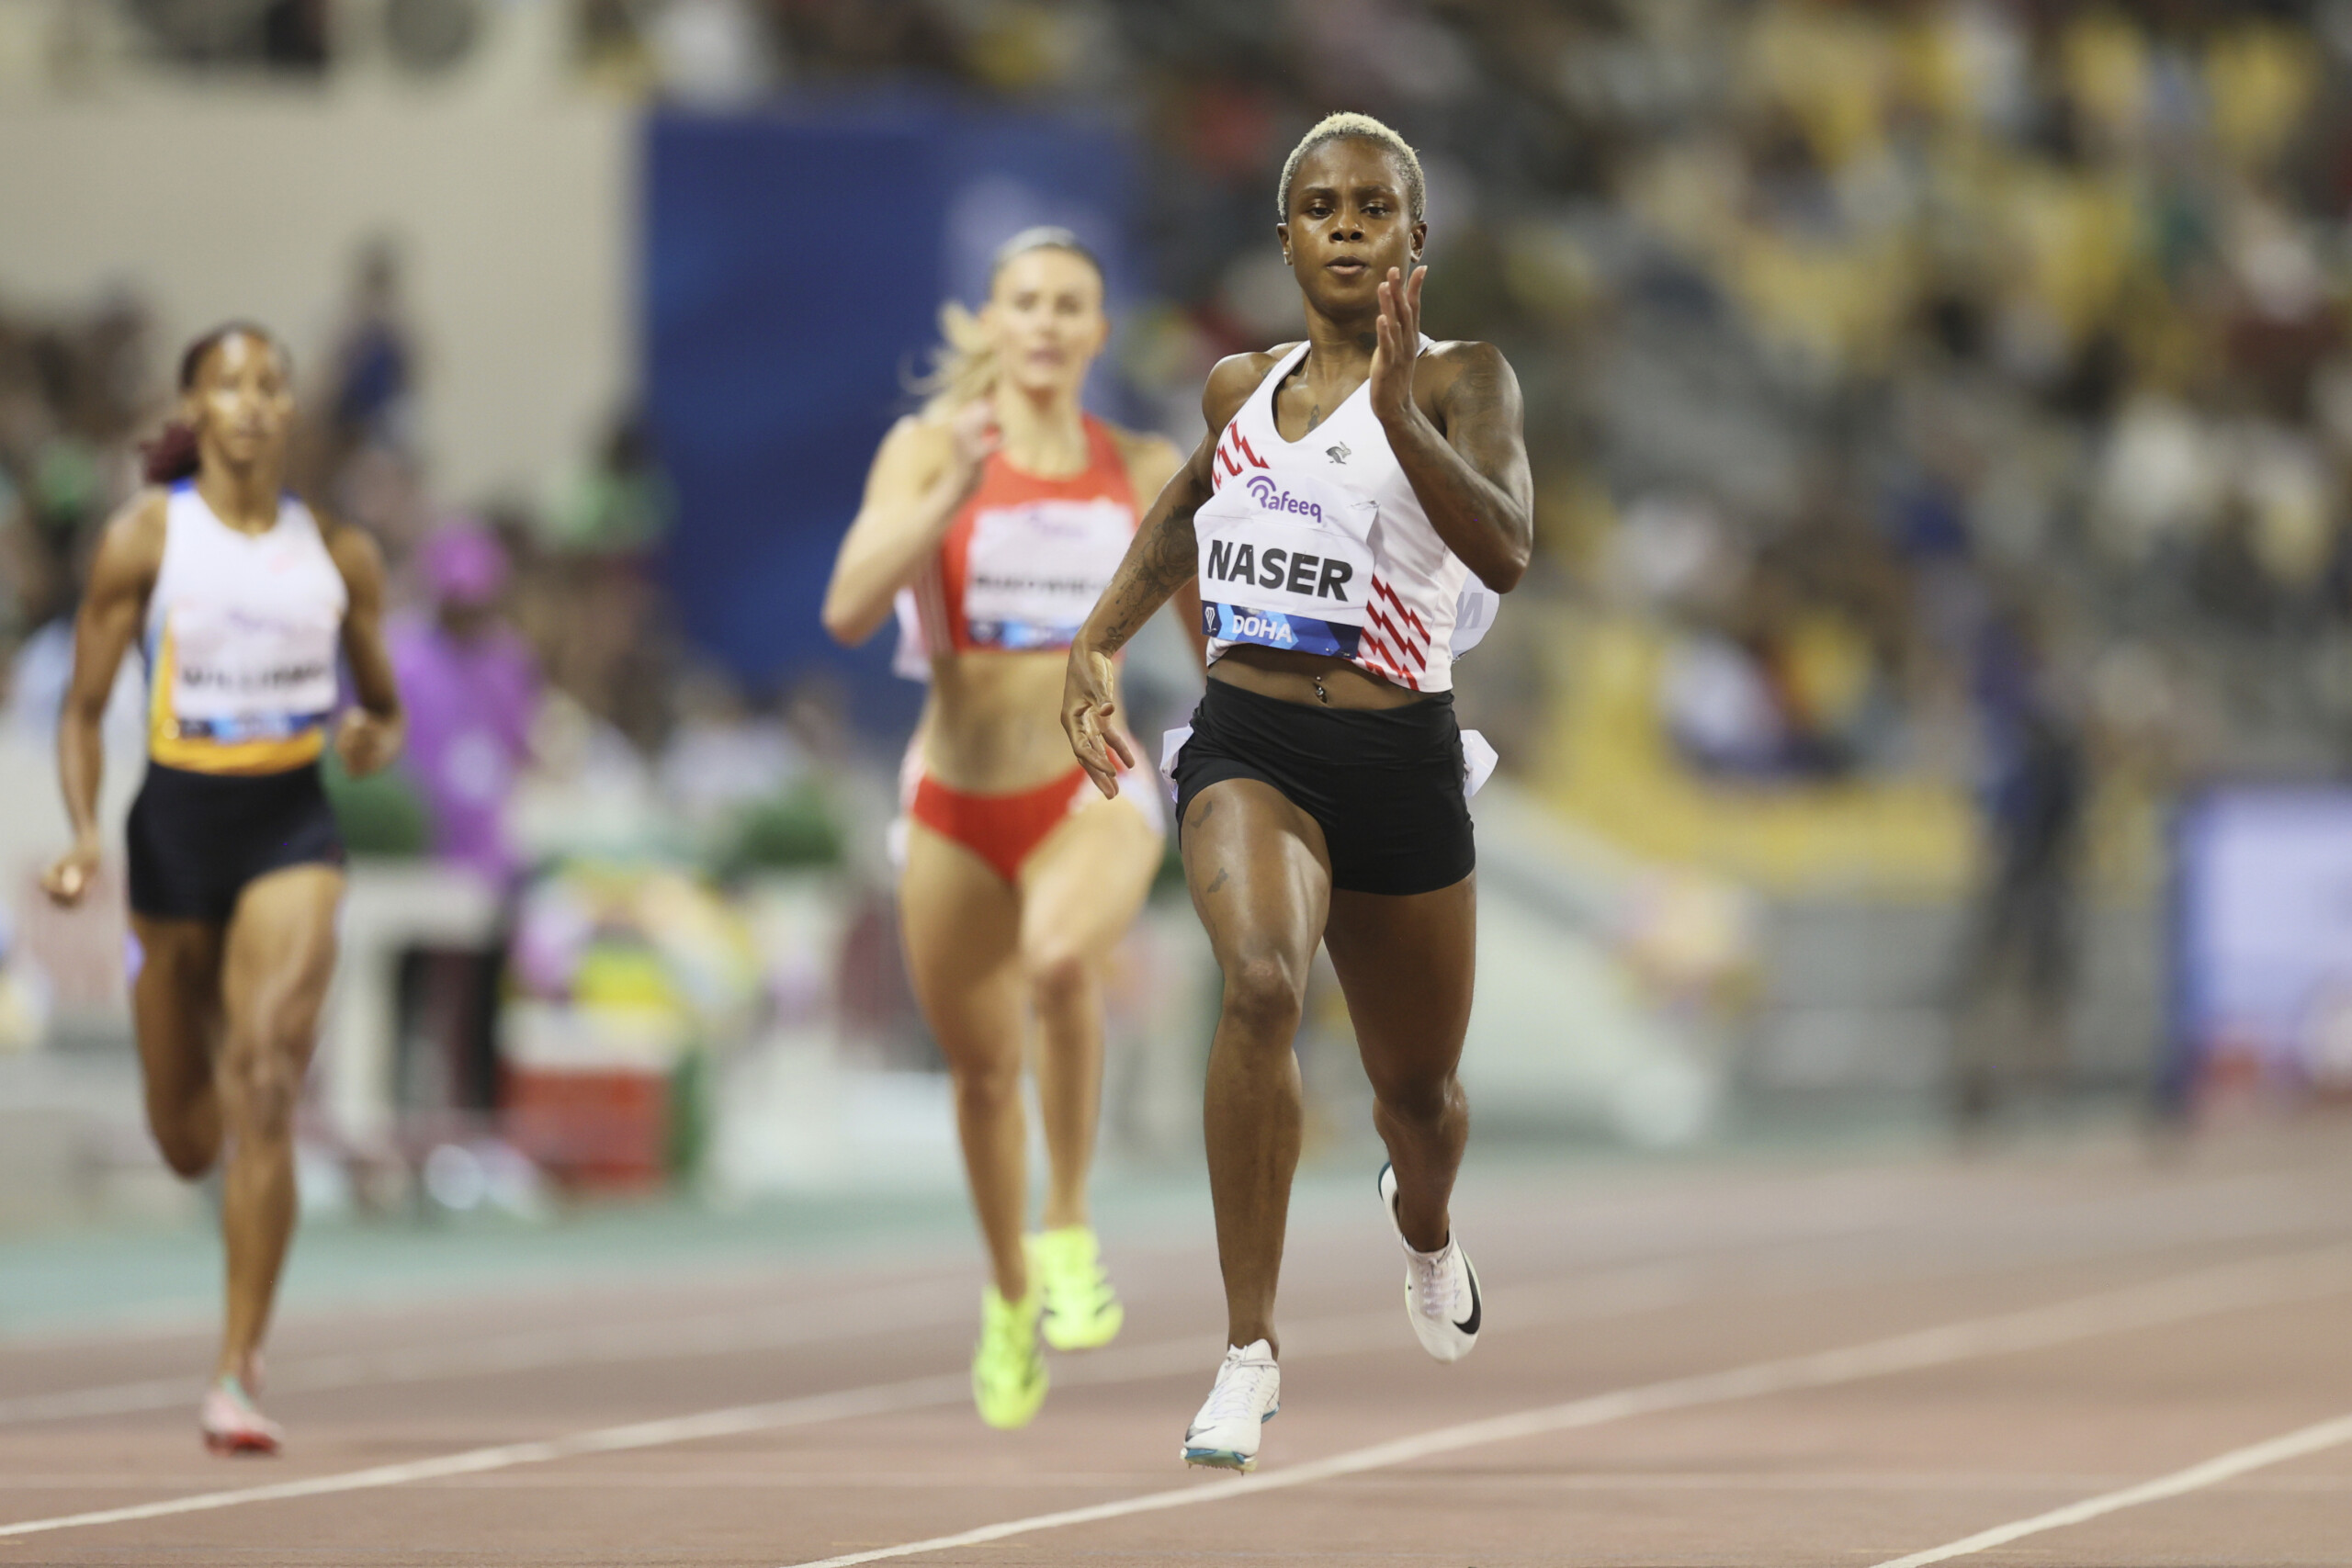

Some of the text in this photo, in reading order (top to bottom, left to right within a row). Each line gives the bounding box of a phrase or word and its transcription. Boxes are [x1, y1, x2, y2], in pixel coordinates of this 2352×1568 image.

[1247, 475, 1322, 523] Rafeeq
[1207, 539, 1353, 602] NASER
[1232, 615, 1293, 642] DOHA
